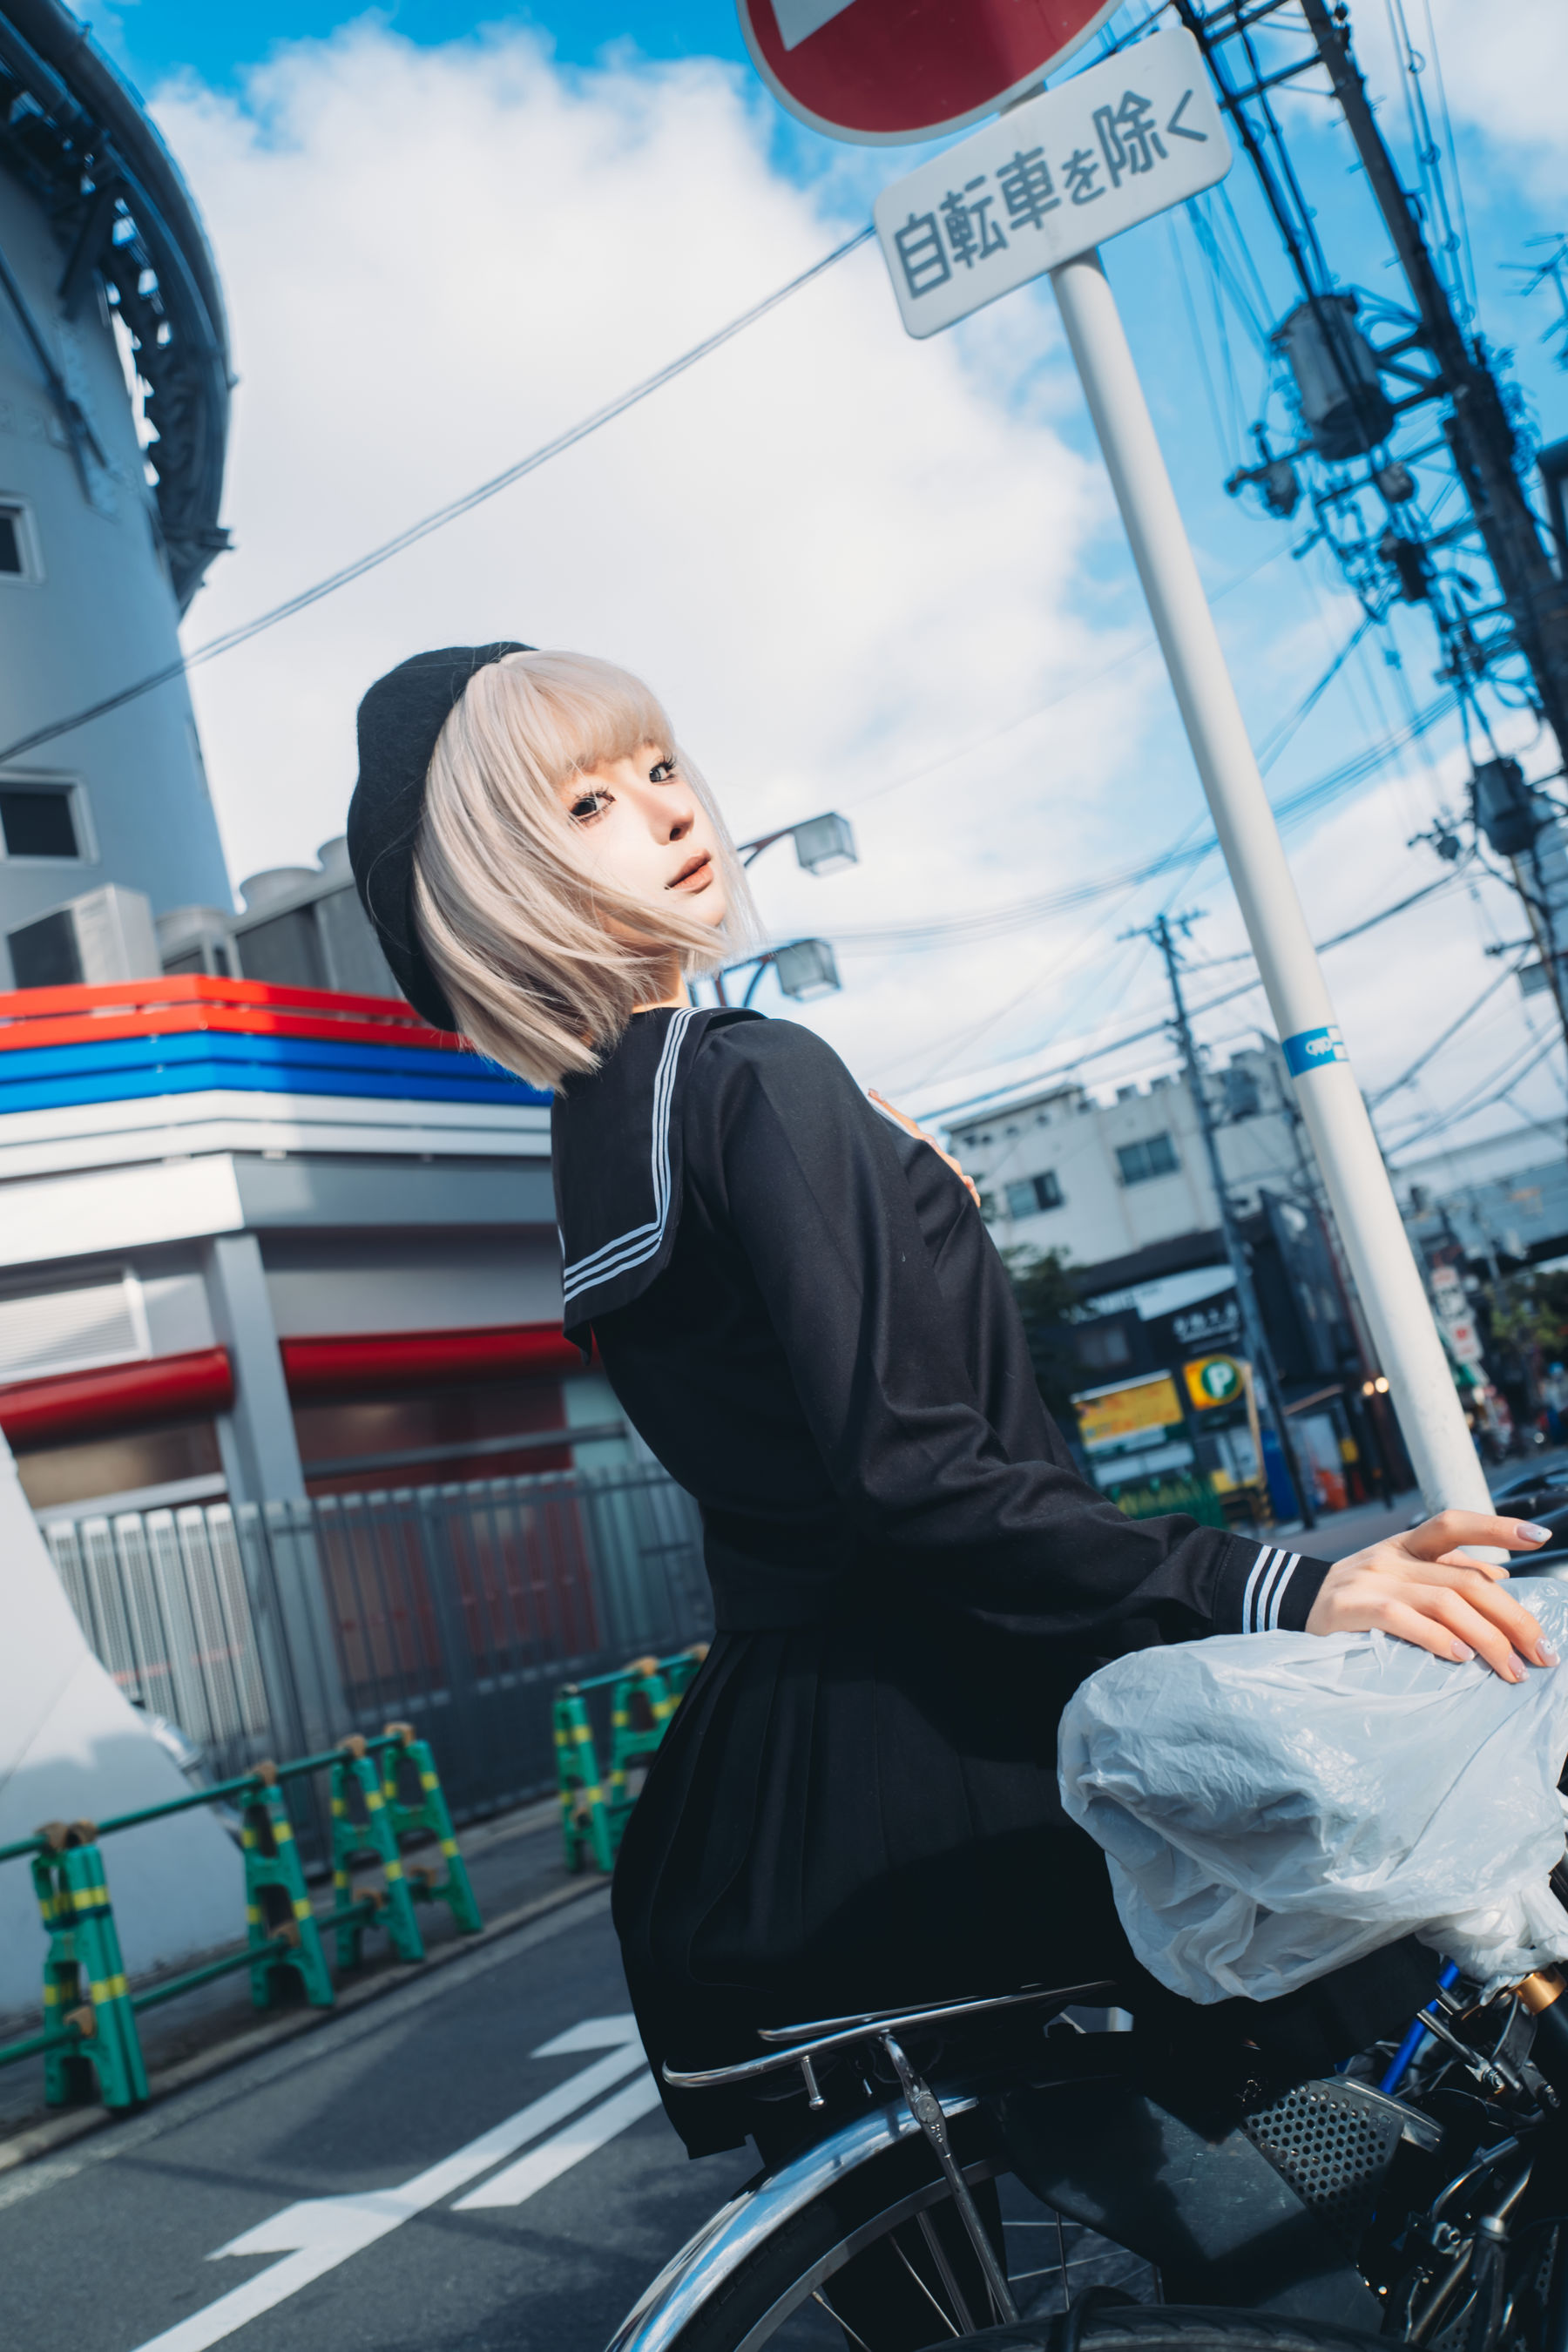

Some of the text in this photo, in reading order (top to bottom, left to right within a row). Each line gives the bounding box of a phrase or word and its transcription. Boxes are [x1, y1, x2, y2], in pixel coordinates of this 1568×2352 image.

[894, 90, 1207, 300] 自転車を除く
[1207, 1362, 1233, 1398] P
